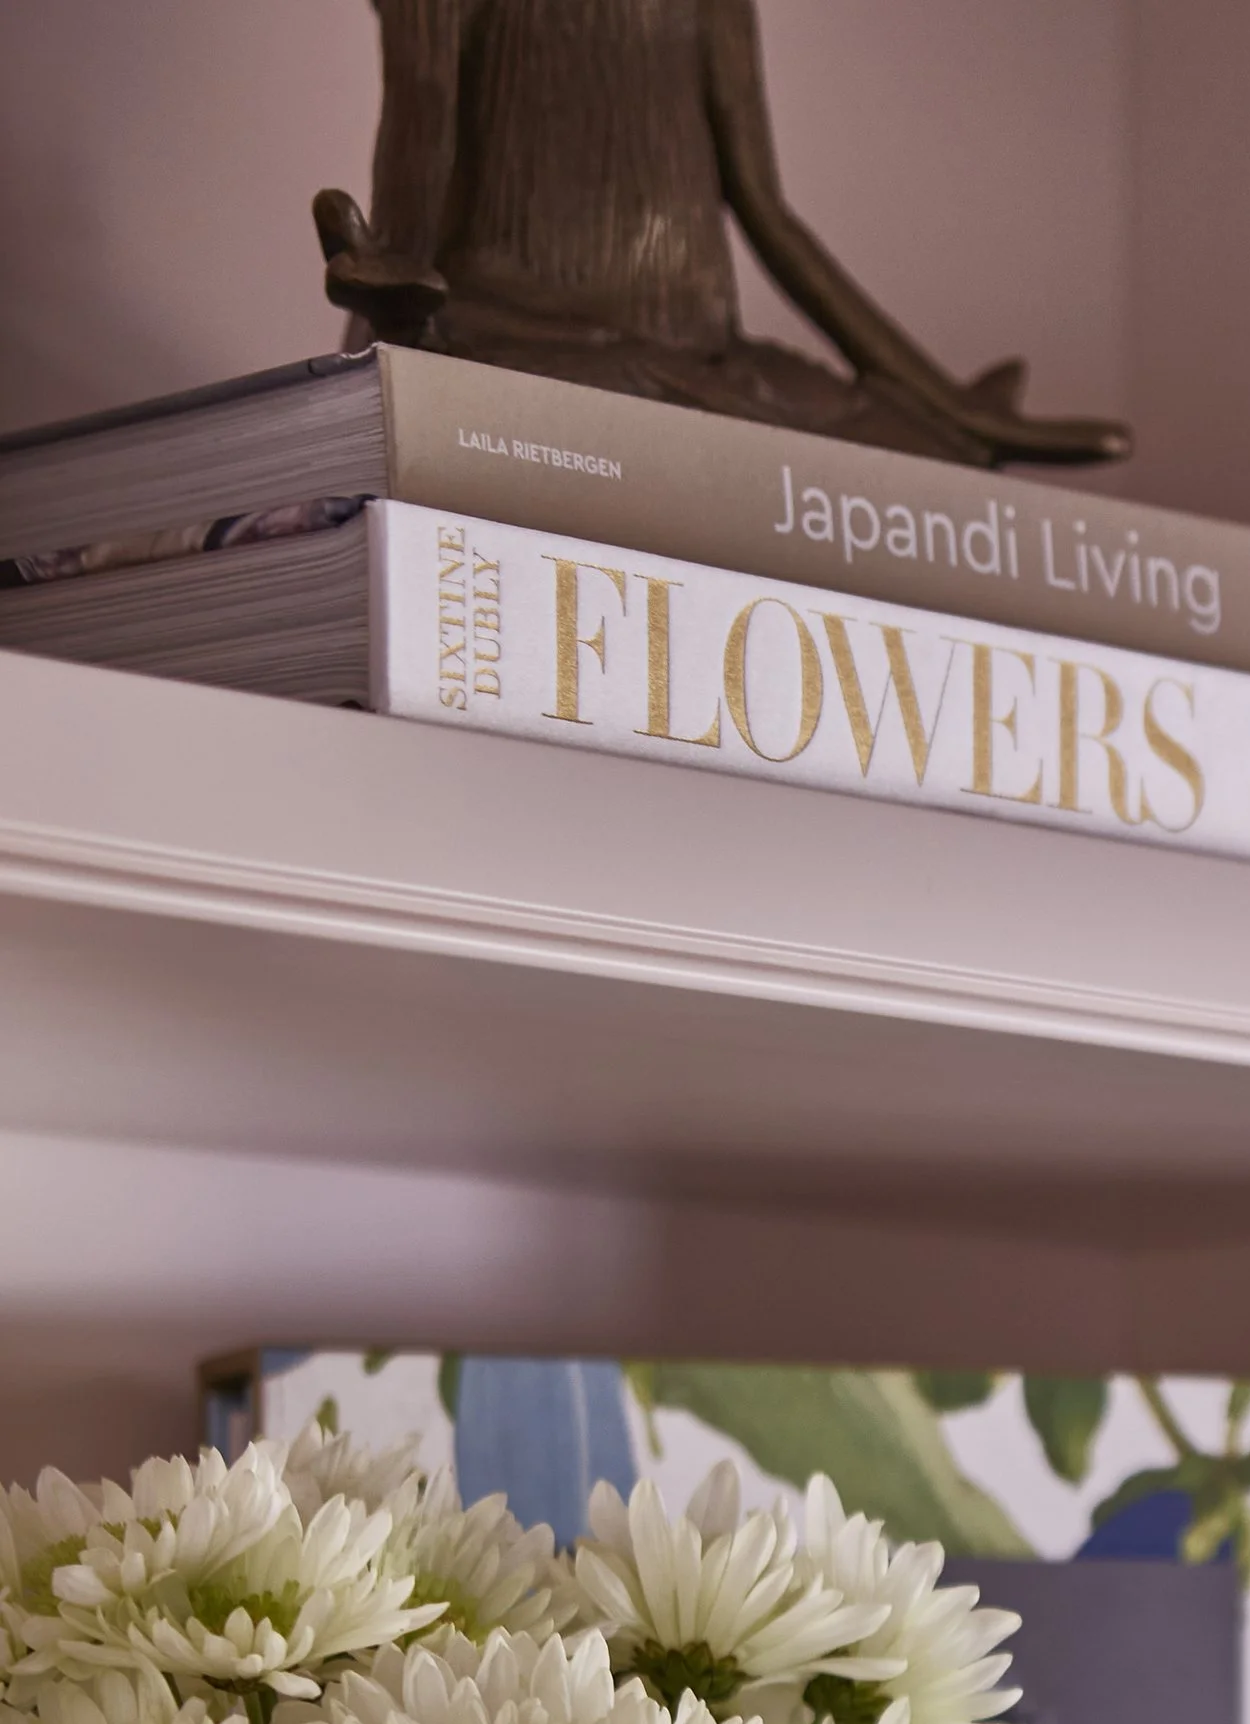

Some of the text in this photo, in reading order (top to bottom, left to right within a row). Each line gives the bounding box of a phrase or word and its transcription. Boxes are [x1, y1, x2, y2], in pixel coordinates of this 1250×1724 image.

[458, 427, 622, 480] LAILA RIETBERGEN
[437, 526, 467, 711] SIXTINE
[472, 546, 501, 699] DUBLY
[774, 464, 1223, 635] Japandi Living
[540, 554, 1206, 834] FLOWERS
